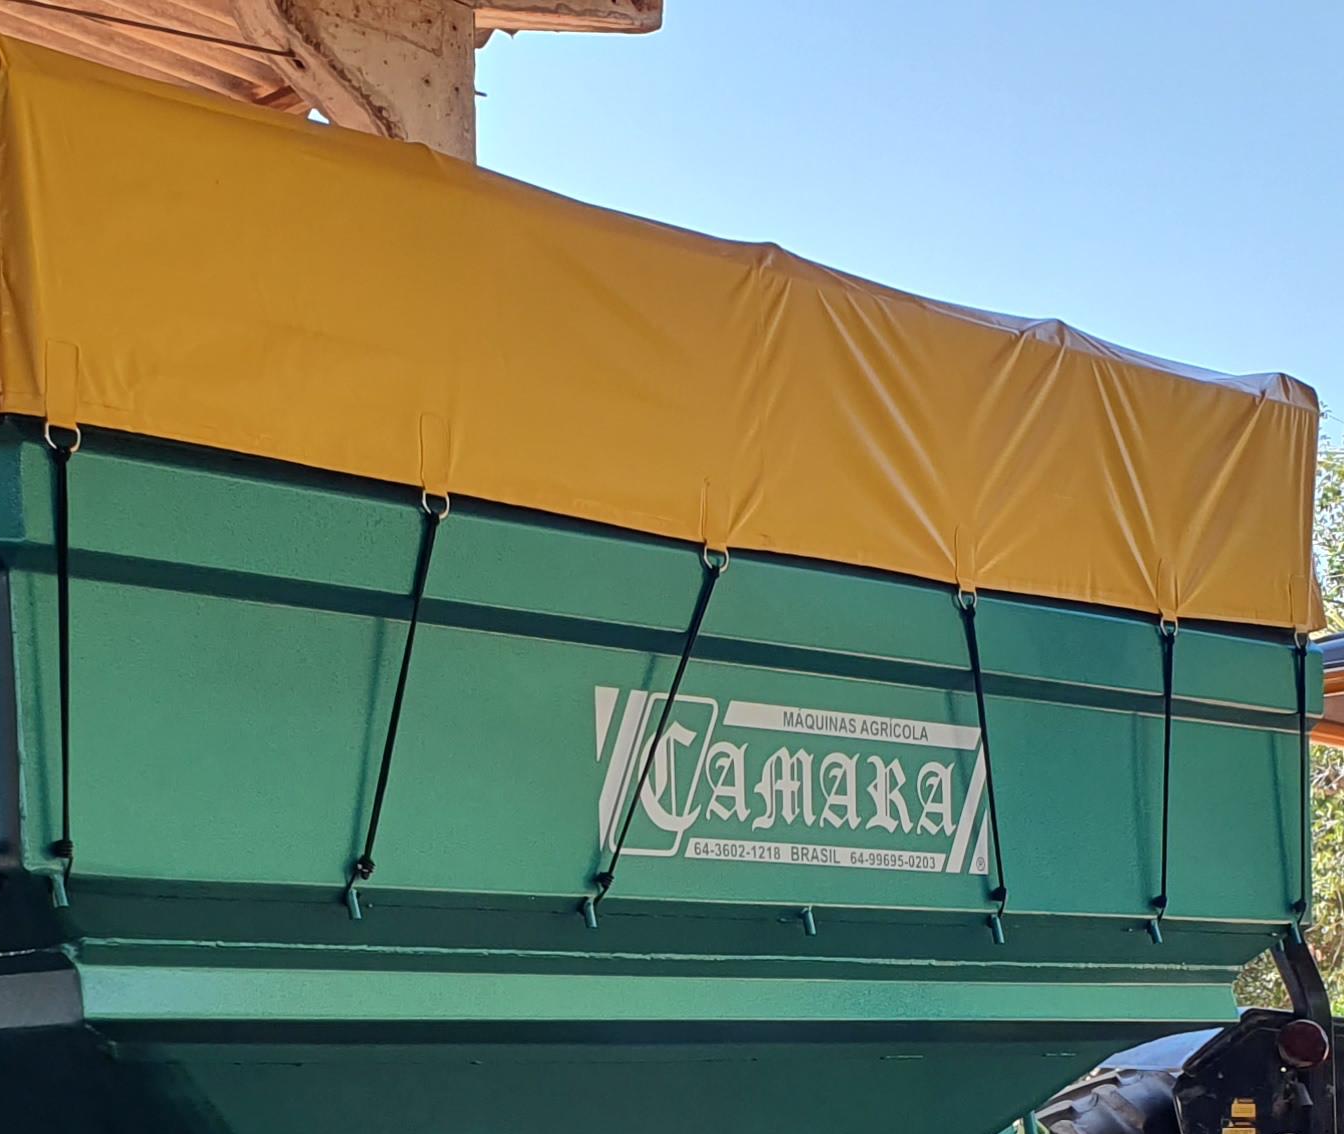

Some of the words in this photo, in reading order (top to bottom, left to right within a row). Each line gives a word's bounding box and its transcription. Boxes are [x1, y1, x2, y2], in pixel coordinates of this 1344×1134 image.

[639, 720, 956, 837] CAMARA
[693, 842, 781, 860] 64-3602-1218
[790, 846, 841, 864] BRASIL
[850, 852, 936, 870] 64-99695-0203
